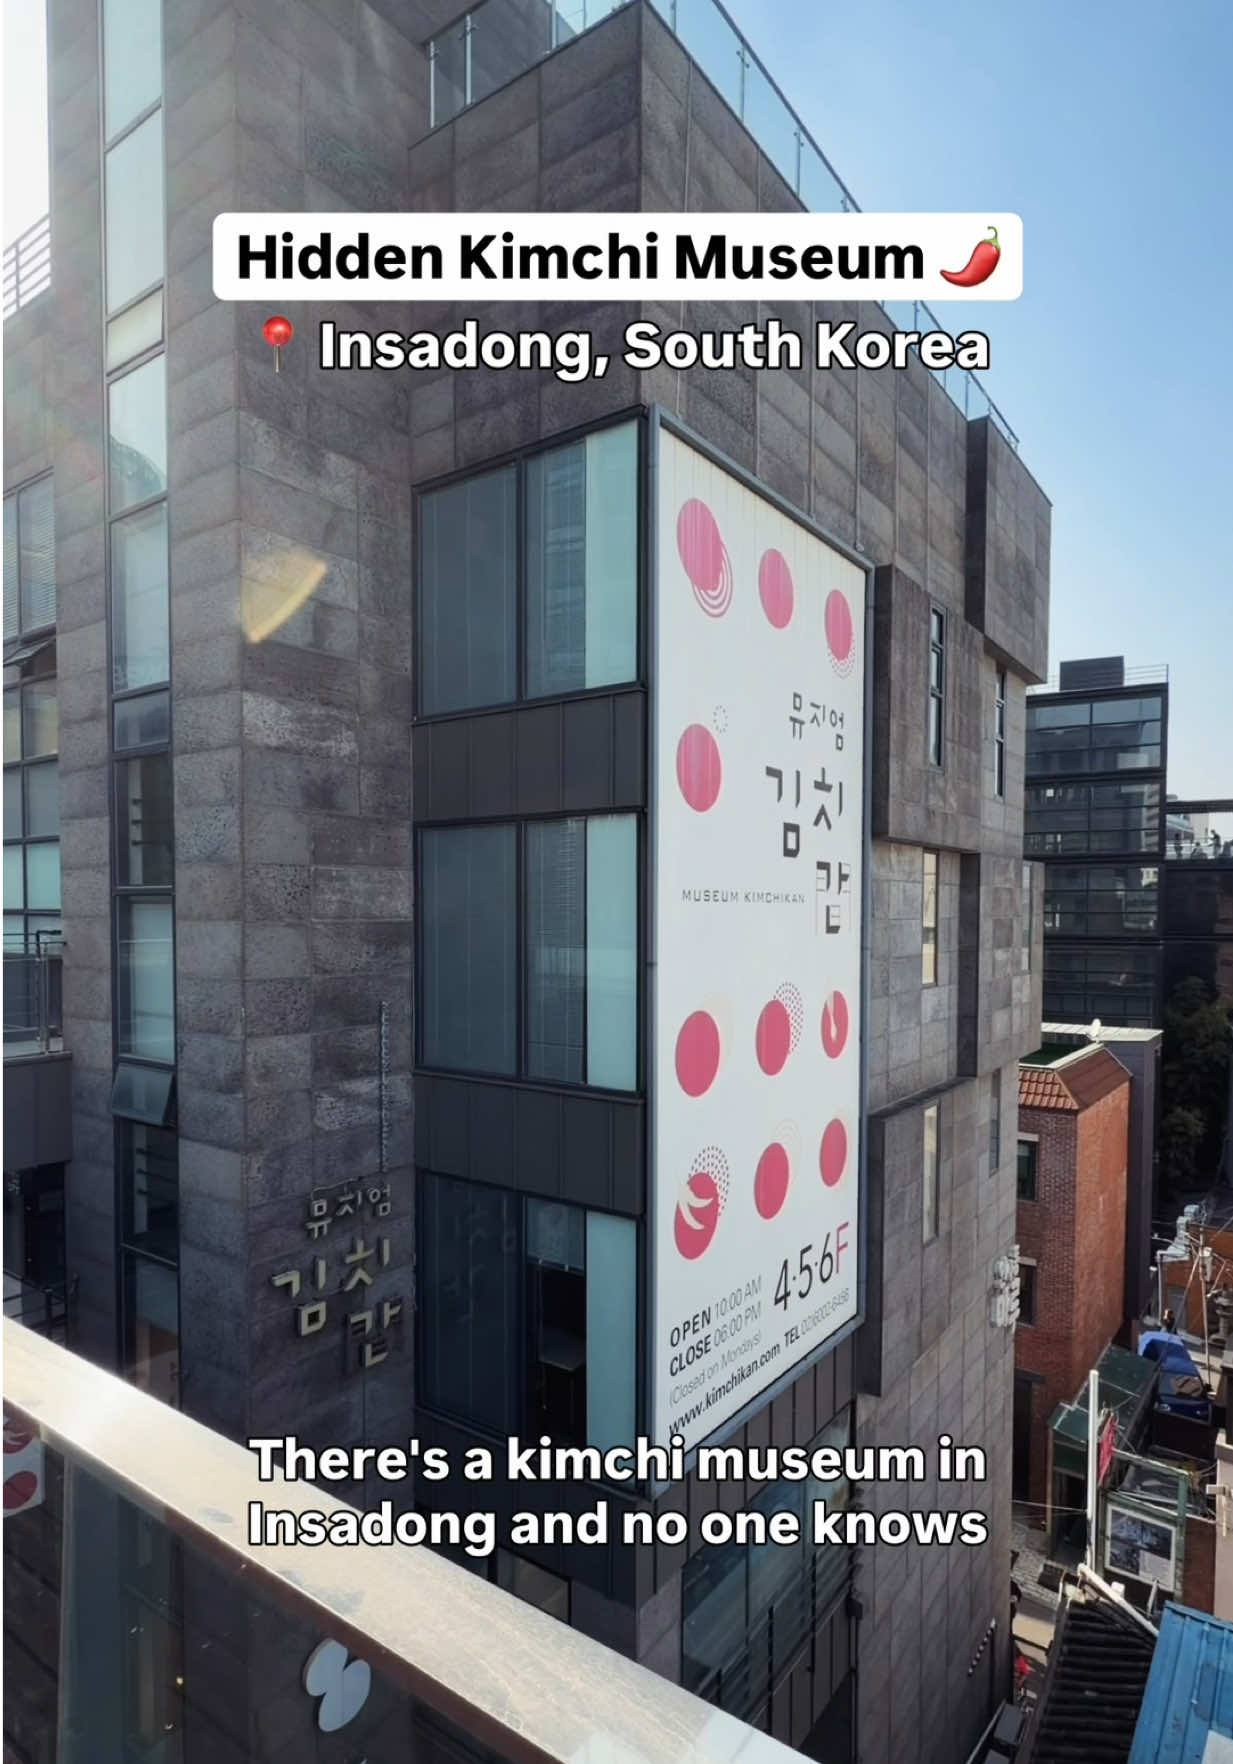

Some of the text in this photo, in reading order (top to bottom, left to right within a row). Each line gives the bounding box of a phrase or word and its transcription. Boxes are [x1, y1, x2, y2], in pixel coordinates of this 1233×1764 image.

[789, 692, 844, 751] 뮤지엄
[682, 889, 805, 904] MUSEUM KIMCHIKAN
[307, 1184, 391, 1240] 뮤지엄
[670, 1306, 711, 1347] OPEN
[744, 1275, 762, 1298] AM
[670, 1334, 711, 1377] CLOSE
[744, 1301, 762, 1327] PM
[668, 1342, 780, 1437] www.kimchikan.com
[784, 1326, 800, 1347] TEL
[707, 1362, 719, 1379] on
